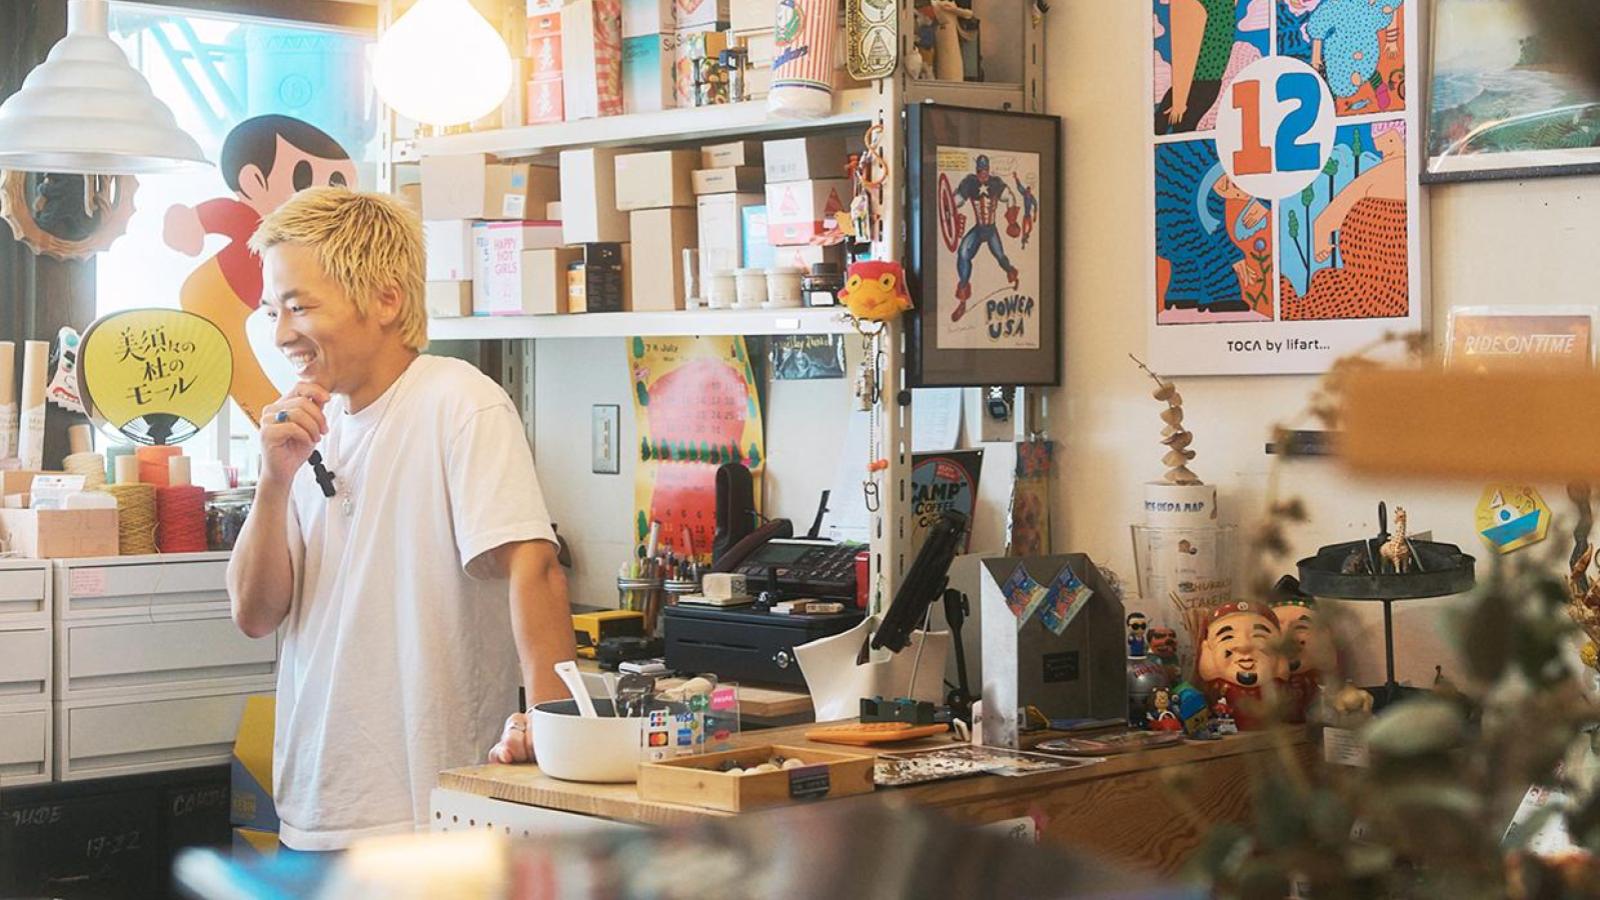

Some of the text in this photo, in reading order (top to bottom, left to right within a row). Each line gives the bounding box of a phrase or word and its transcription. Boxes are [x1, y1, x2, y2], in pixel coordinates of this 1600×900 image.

[1232, 72, 1321, 176] 12
[495, 263, 518, 274] GIRLS
[985, 295, 1034, 321] POWER
[987, 318, 1025, 340] USA
[1227, 340, 1262, 352] TOCA
[1266, 339, 1282, 353] by
[1465, 334, 1577, 353] RIDE ON TIME
[126, 375, 198, 405] モール
[676, 712, 695, 722] VISA
